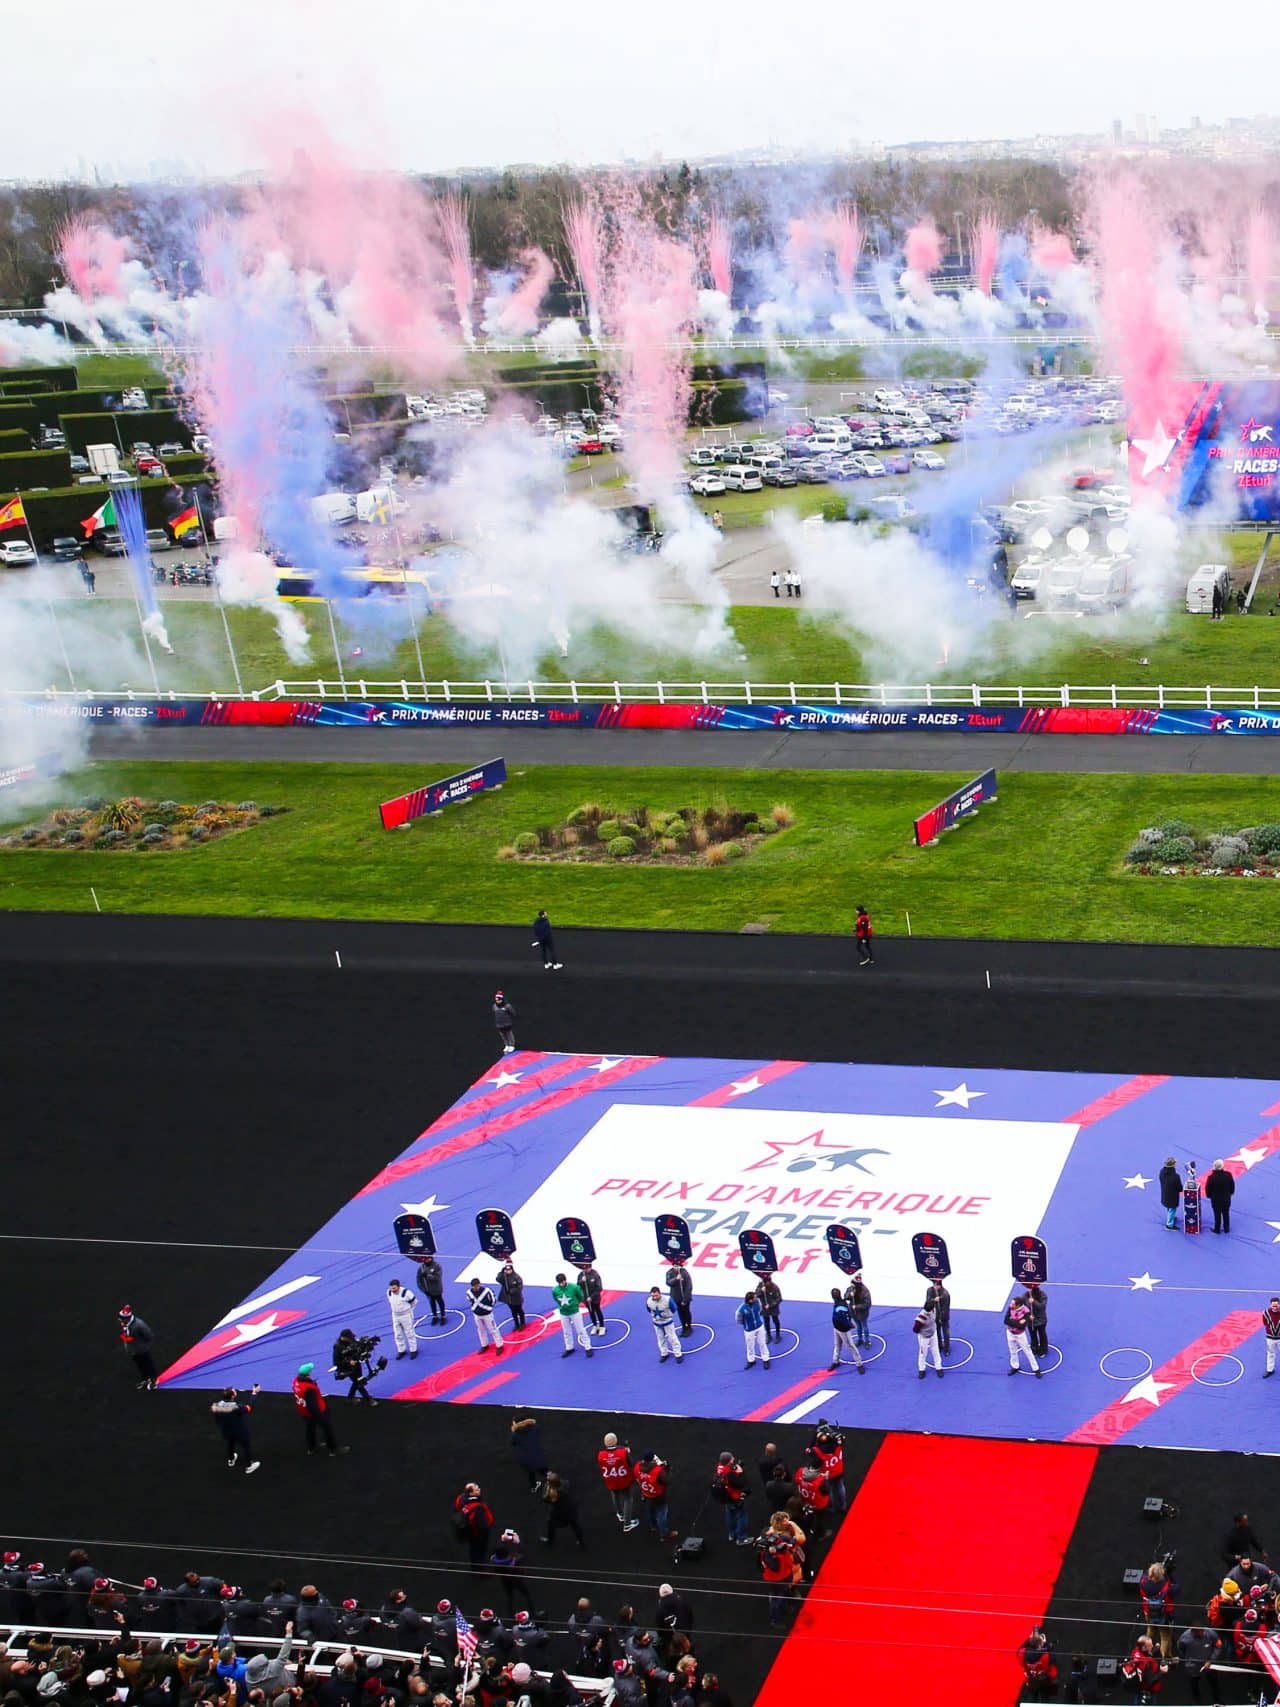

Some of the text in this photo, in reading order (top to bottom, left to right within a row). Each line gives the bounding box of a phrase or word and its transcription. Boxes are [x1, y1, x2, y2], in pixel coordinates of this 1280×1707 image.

[392, 709, 419, 721] PRIX
[800, 712, 828, 724] PRIX
[1238, 717, 1269, 729] PRIX
[591, 1178, 992, 1215] PRIX D'AMÉRIQUE
[566, 1219, 577, 1232] 3
[601, 1466, 627, 1478] 246
